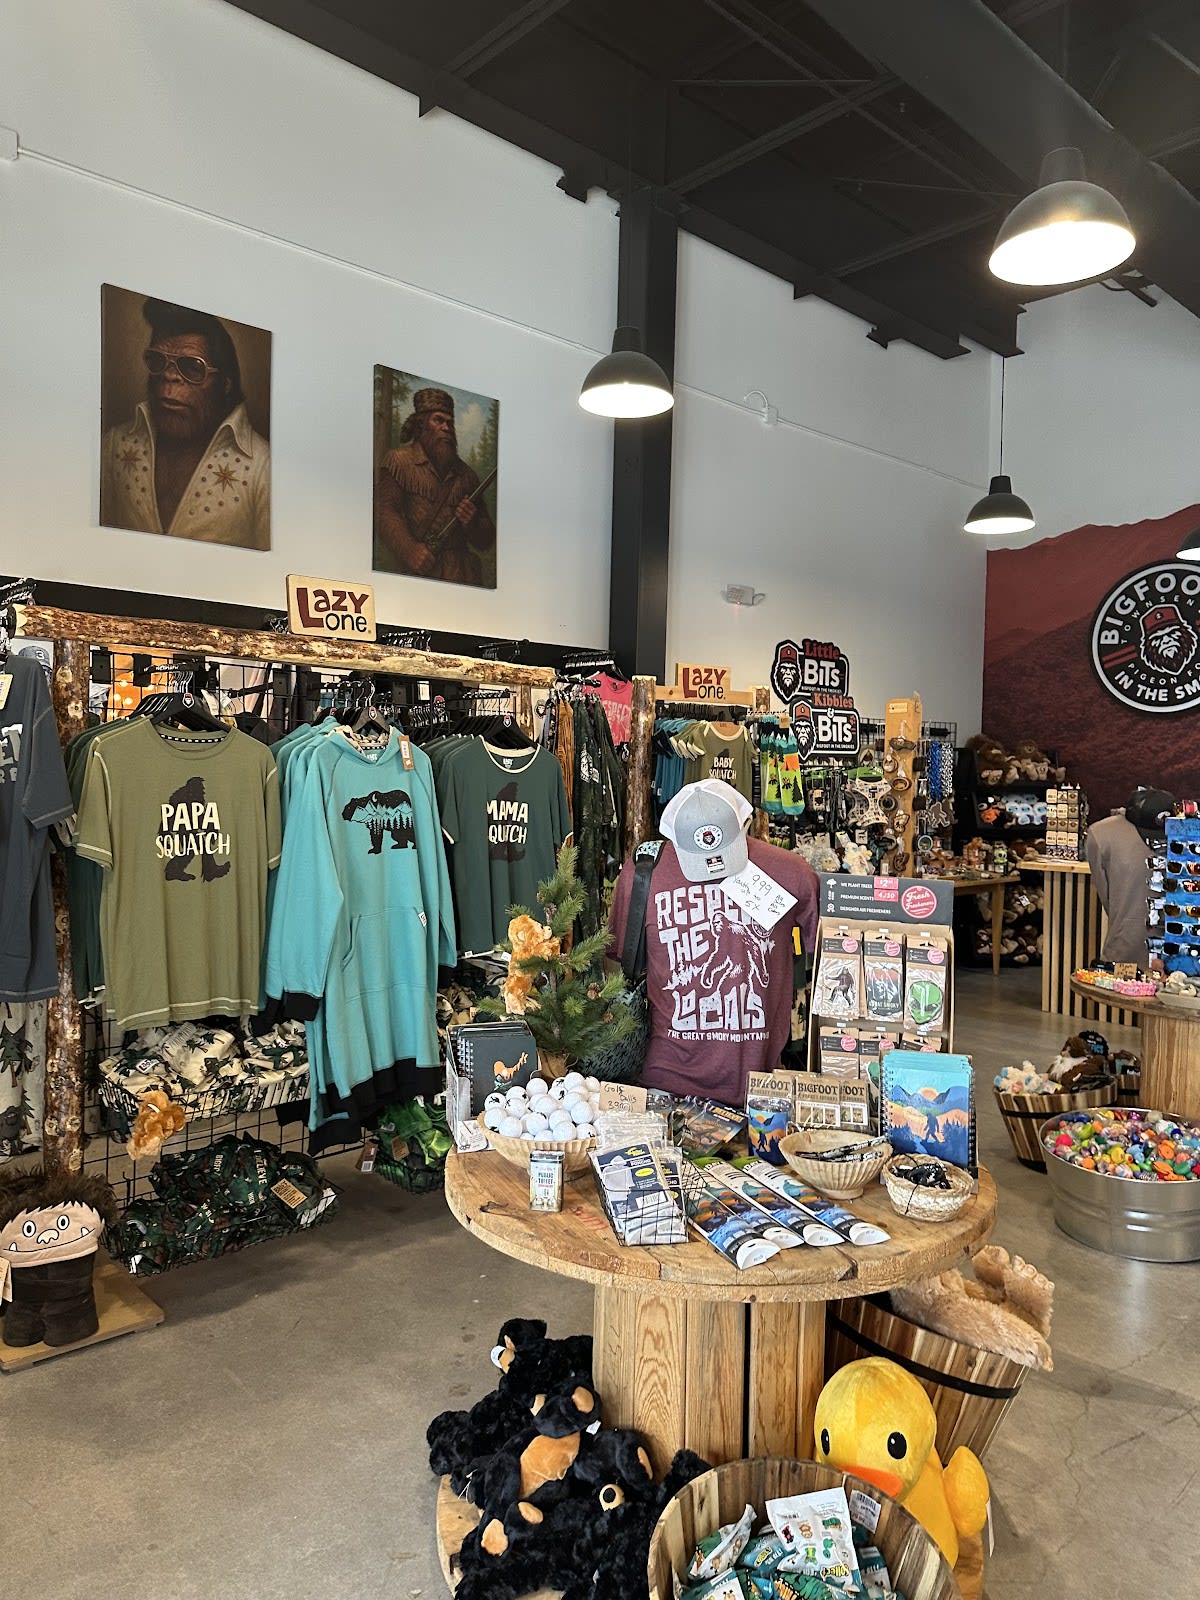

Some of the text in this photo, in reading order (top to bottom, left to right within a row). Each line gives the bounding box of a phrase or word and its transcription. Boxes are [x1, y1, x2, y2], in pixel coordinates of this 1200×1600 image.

[1120, 594, 1200, 645] TOWNSEN
[804, 640, 841, 660] Little
[1128, 663, 1178, 685] PIGEON
[1114, 670, 1200, 702] IN THE SM
[813, 692, 854, 709] Kibbles
[713, 756, 735, 768] BABY
[161, 802, 221, 831] PAPA
[486, 799, 529, 824] MAMA
[155, 831, 231, 859] SQUATCH
[905, 890, 931, 903] Fresh
[658, 921, 711, 971] THE
[671, 981, 766, 1031] LOCALS
[667, 1028, 681, 1040] THE
[681, 1031, 706, 1041] GREAT
[750, 1077, 791, 1092] BIFOOT
[797, 1082, 839, 1096] BIGFOOT
